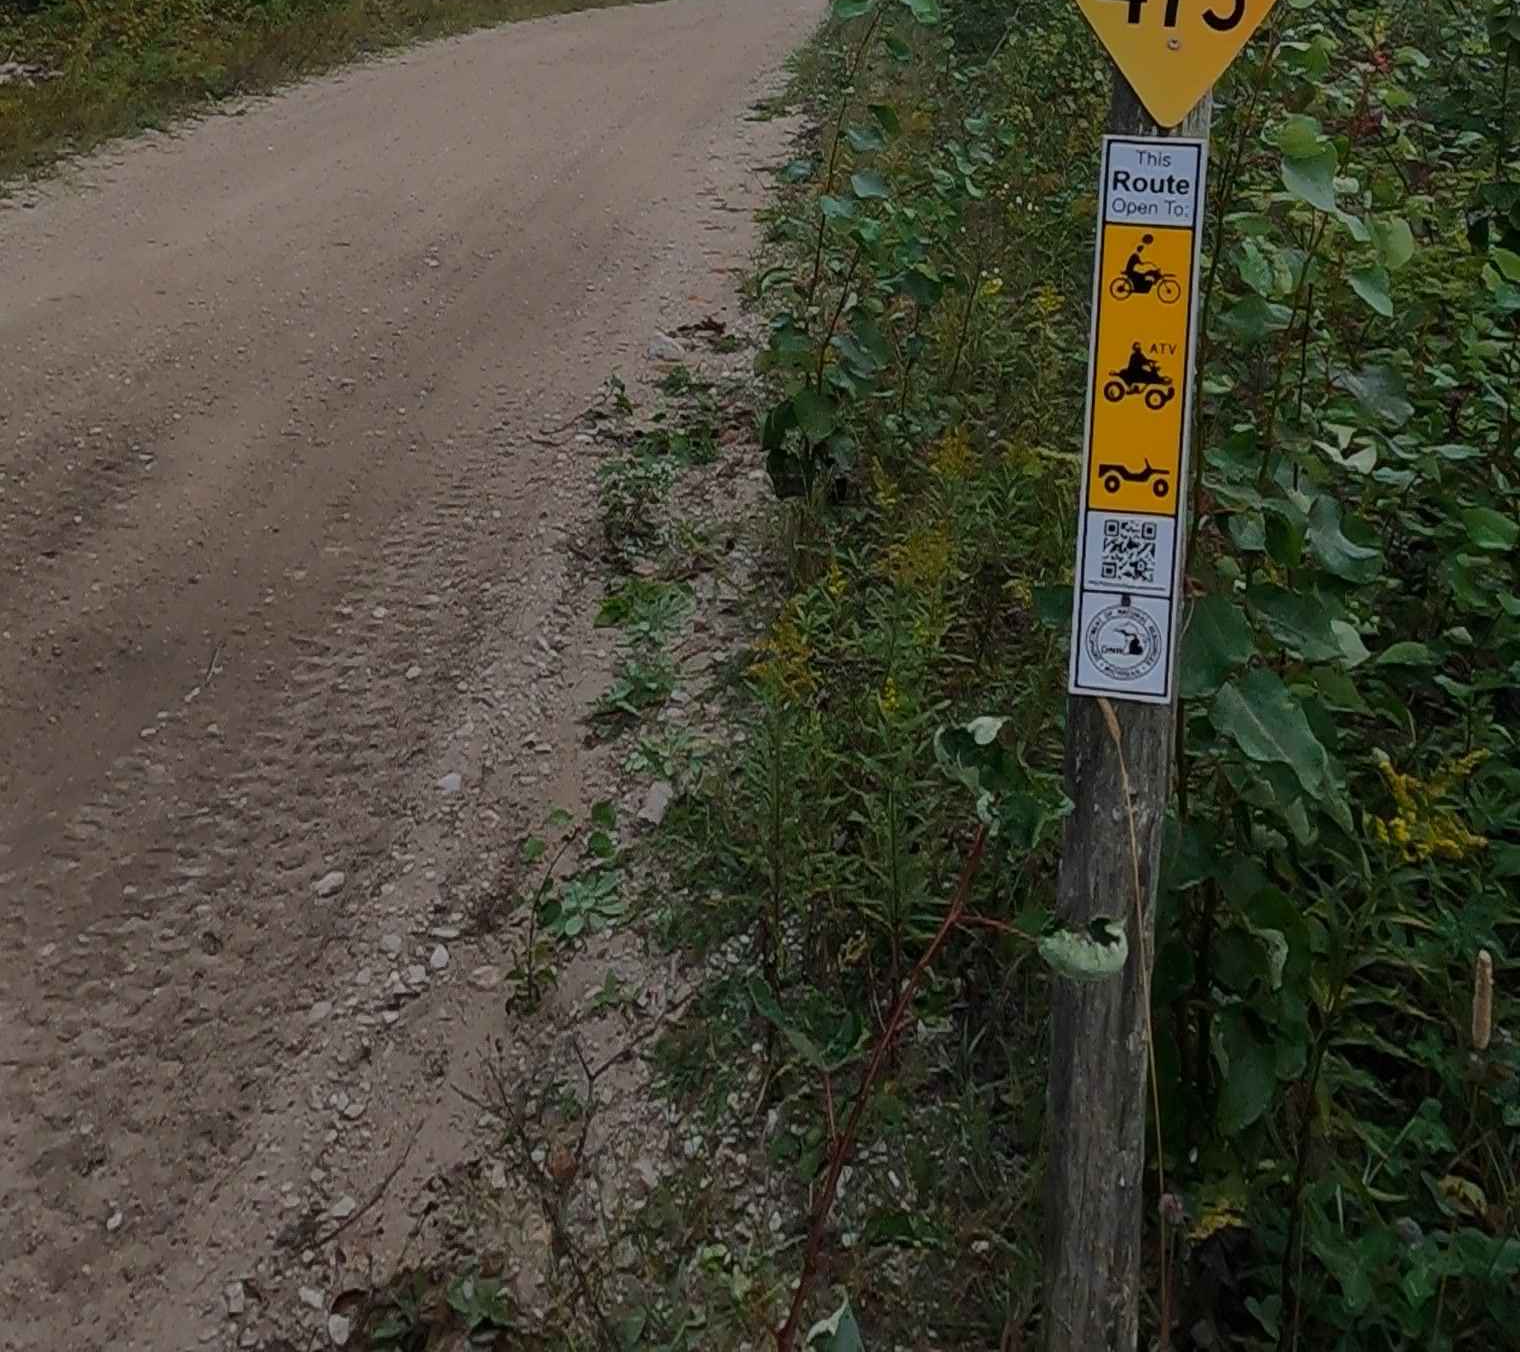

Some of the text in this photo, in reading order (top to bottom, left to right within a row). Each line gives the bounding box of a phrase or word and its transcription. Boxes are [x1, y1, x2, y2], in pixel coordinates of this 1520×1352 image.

[1135, 149, 1172, 167] This
[1112, 170, 1190, 195] Route
[1111, 197, 1159, 216] Open
[1150, 342, 1177, 355] ATV
